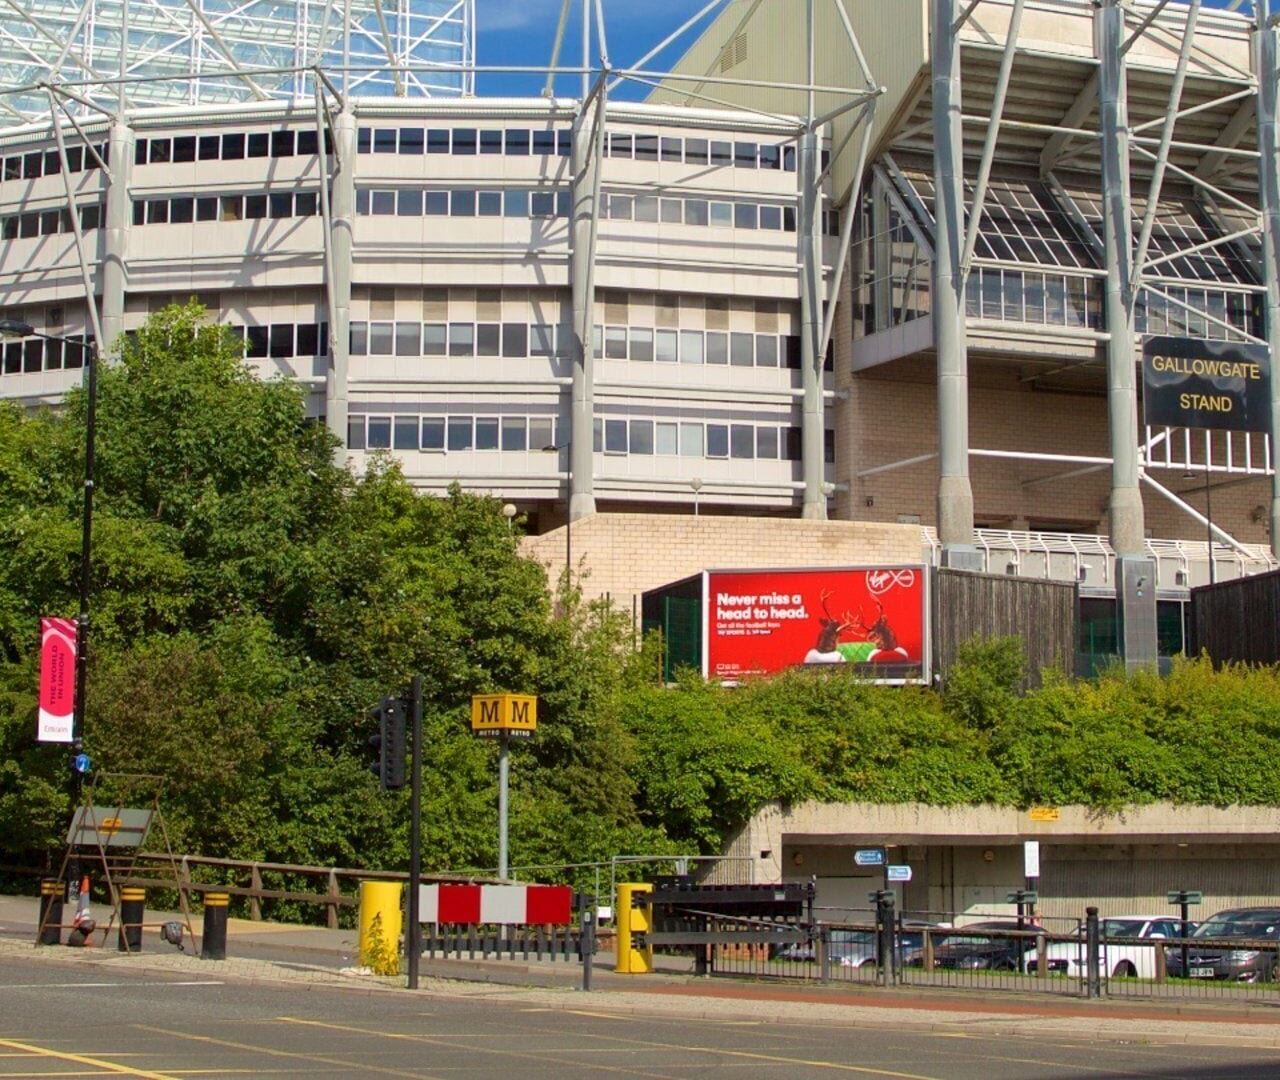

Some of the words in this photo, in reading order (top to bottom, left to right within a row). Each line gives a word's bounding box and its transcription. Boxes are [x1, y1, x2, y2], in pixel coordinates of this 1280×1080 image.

[1152, 355, 1261, 379] GALLOWGATE
[1180, 393, 1233, 412] STAND
[717, 593, 757, 606] Never
[759, 592, 790, 605] miss
[792, 594, 802, 605] a
[717, 606, 751, 620] head
[753, 608, 768, 619] to
[770, 606, 809, 619] head.
[50, 645, 58, 684] WORLD
[480, 701, 499, 723] M
[511, 701, 530, 723] M
